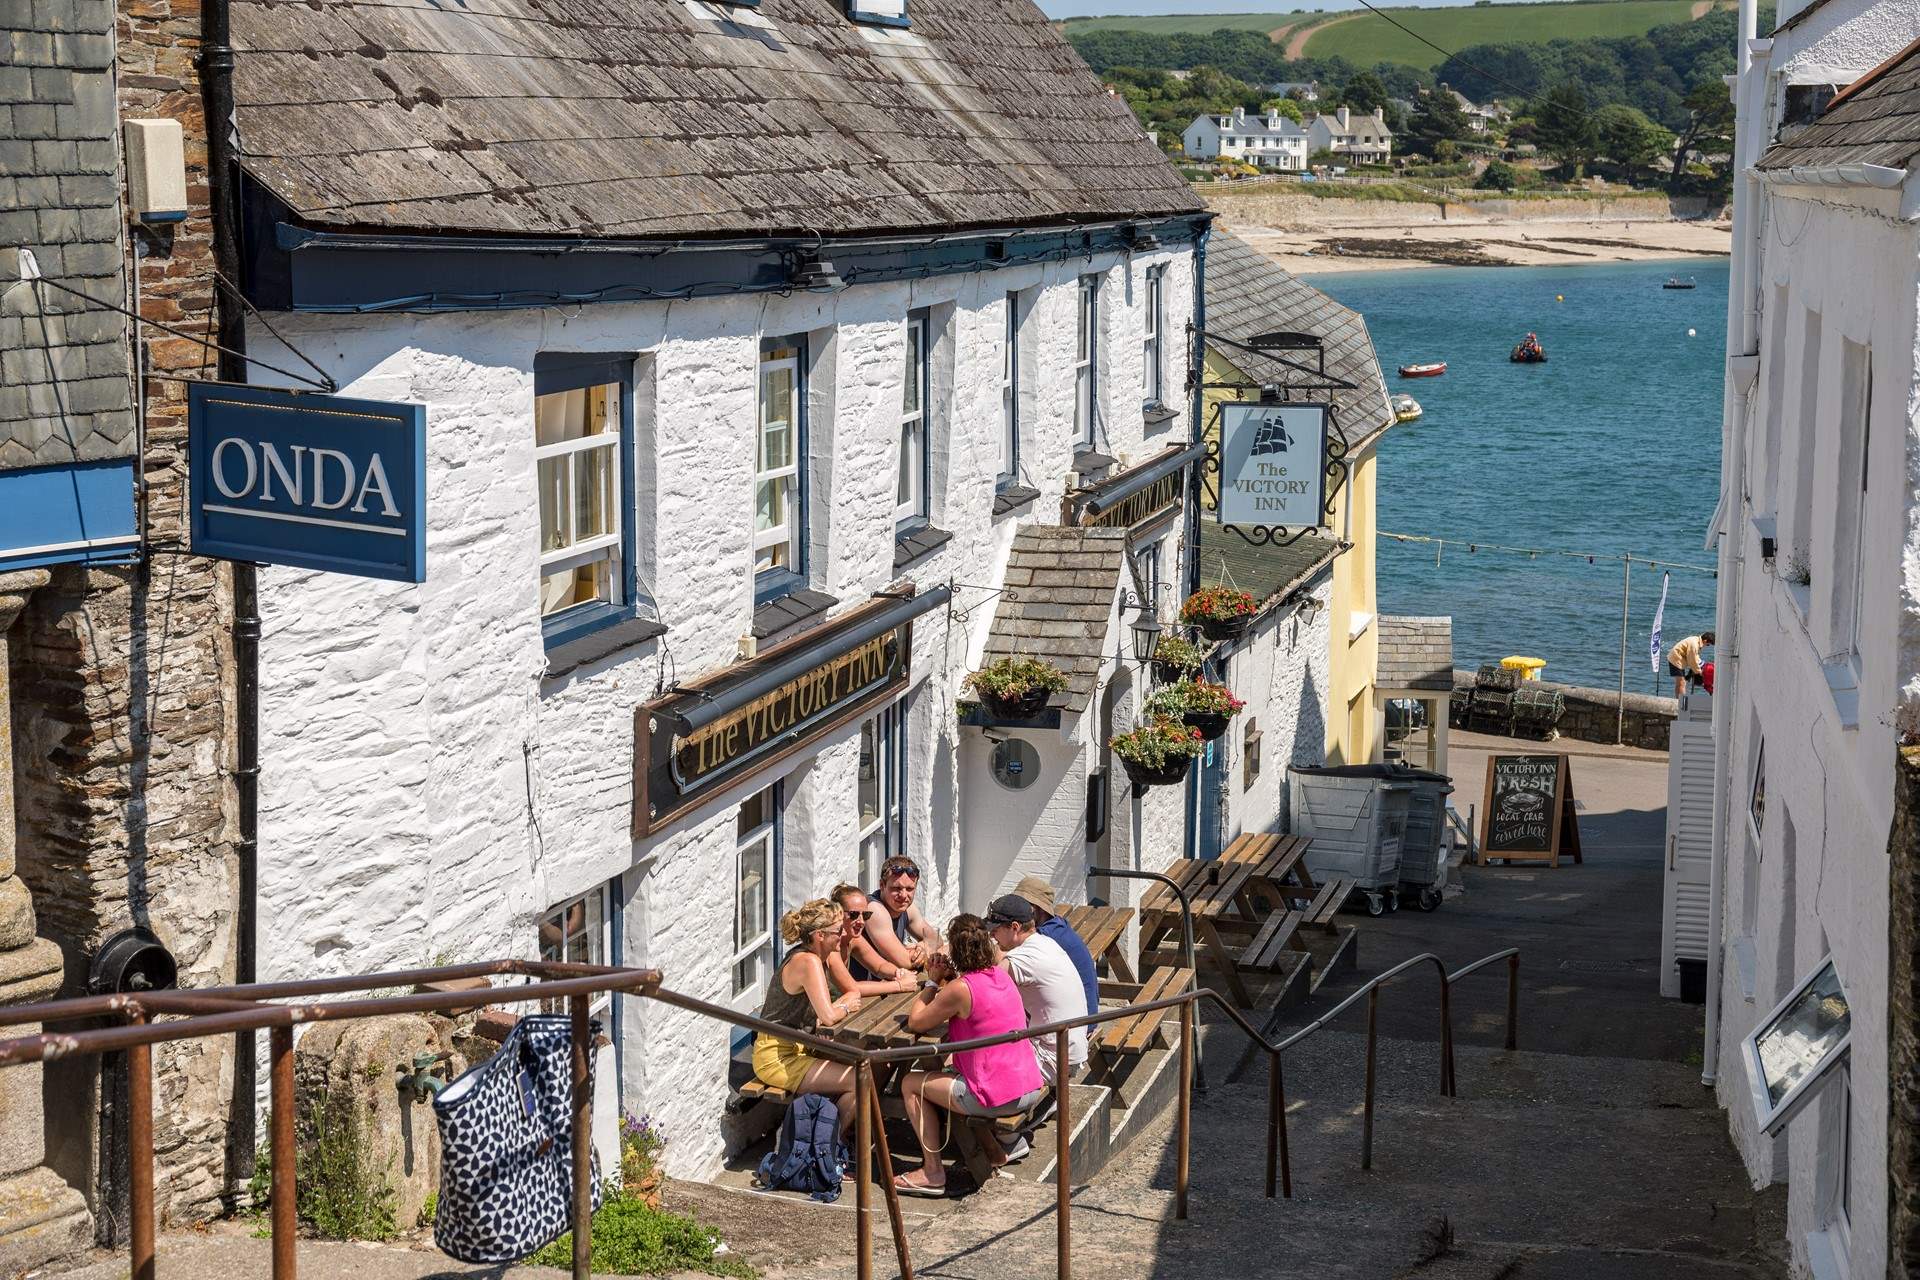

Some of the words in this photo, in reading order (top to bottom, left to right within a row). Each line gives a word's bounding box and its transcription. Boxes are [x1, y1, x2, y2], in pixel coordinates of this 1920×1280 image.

[1256, 463, 1288, 476] The
[211, 437, 402, 517] ONDA
[1154, 473, 1175, 511] INN
[1232, 480, 1310, 494] VICTORY
[1254, 497, 1288, 511] INN
[697, 721, 738, 774] The
[745, 661, 843, 747] VICTORY
[846, 636, 887, 693] INN
[1496, 764, 1538, 774] VICTORY
[1540, 764, 1556, 774] INN
[1496, 774, 1556, 798] FRESH
[1496, 812, 1521, 822] LOCAL
[1524, 812, 1544, 822] CRAB
